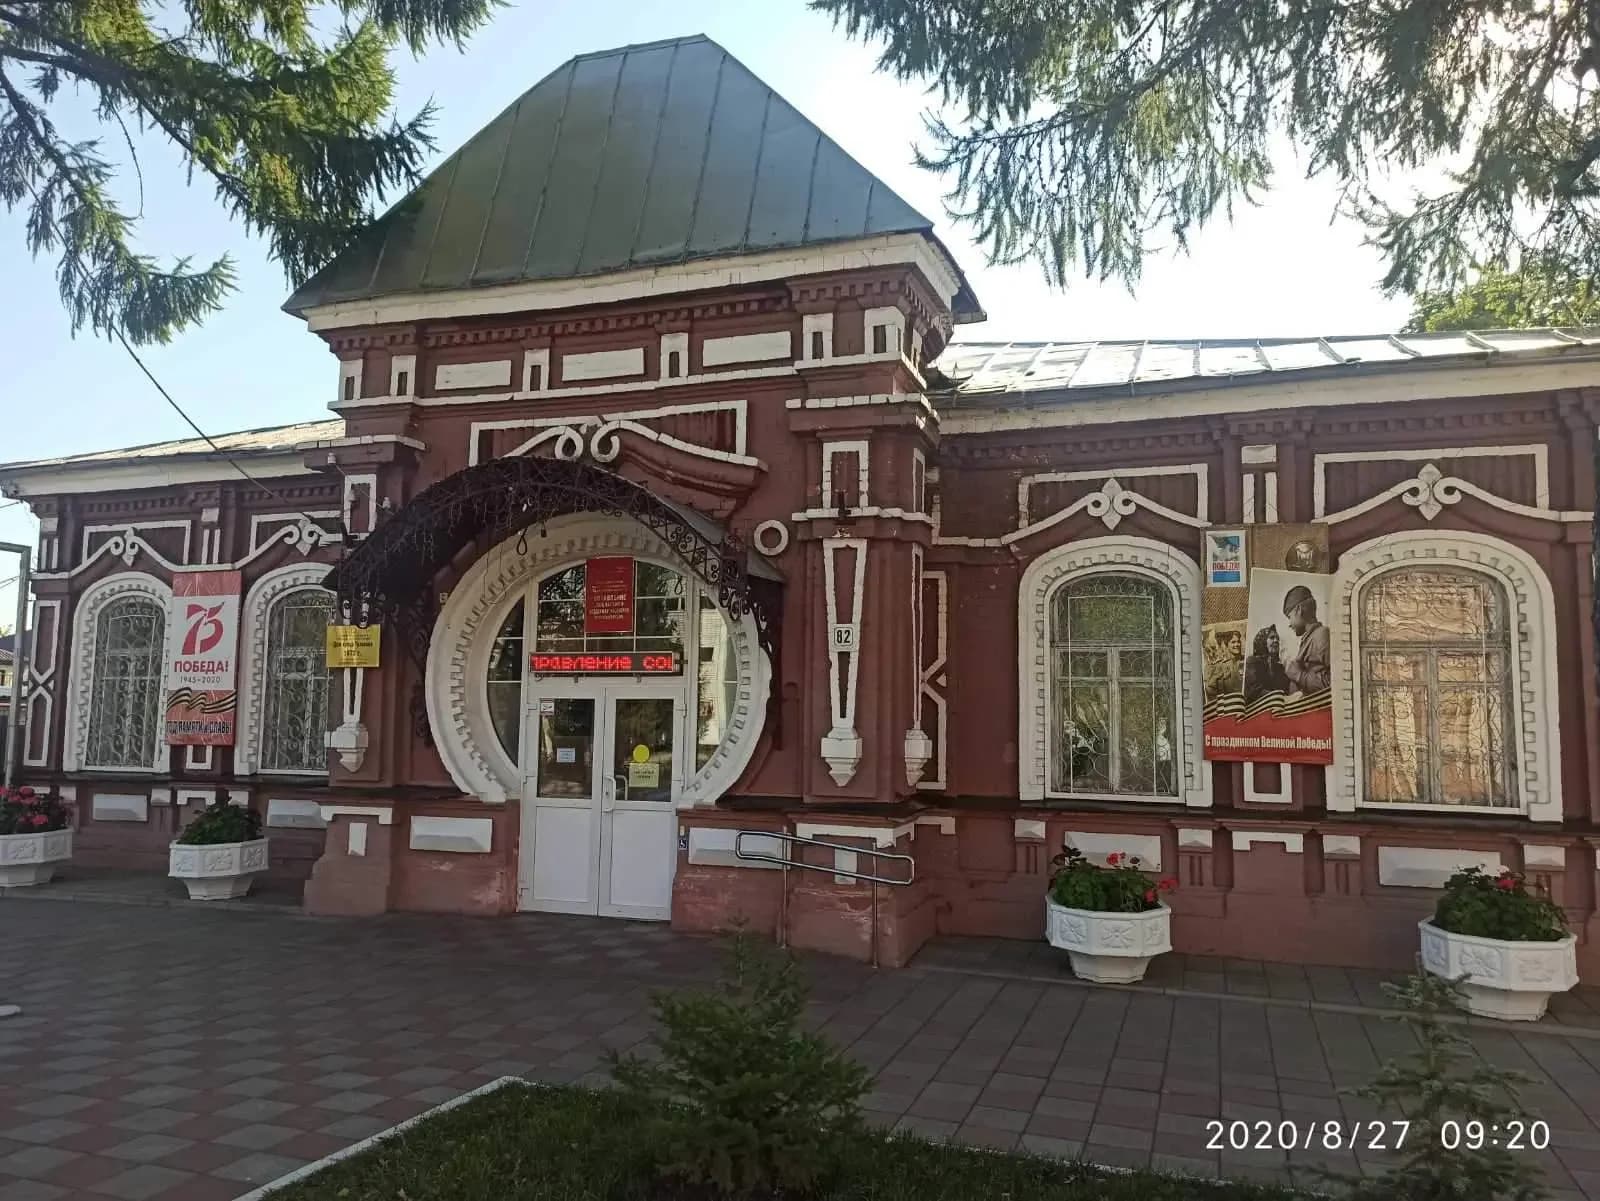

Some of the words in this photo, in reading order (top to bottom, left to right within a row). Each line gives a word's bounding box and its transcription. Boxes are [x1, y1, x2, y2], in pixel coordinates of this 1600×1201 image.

[836, 629, 851, 644] 82
[174, 660, 229, 675] ПОБЕДА!
[1205, 735, 1211, 746] С
[1211, 736, 1260, 748] праздником
[1261, 736, 1296, 748] Великой
[1296, 737, 1332, 750] Победы!
